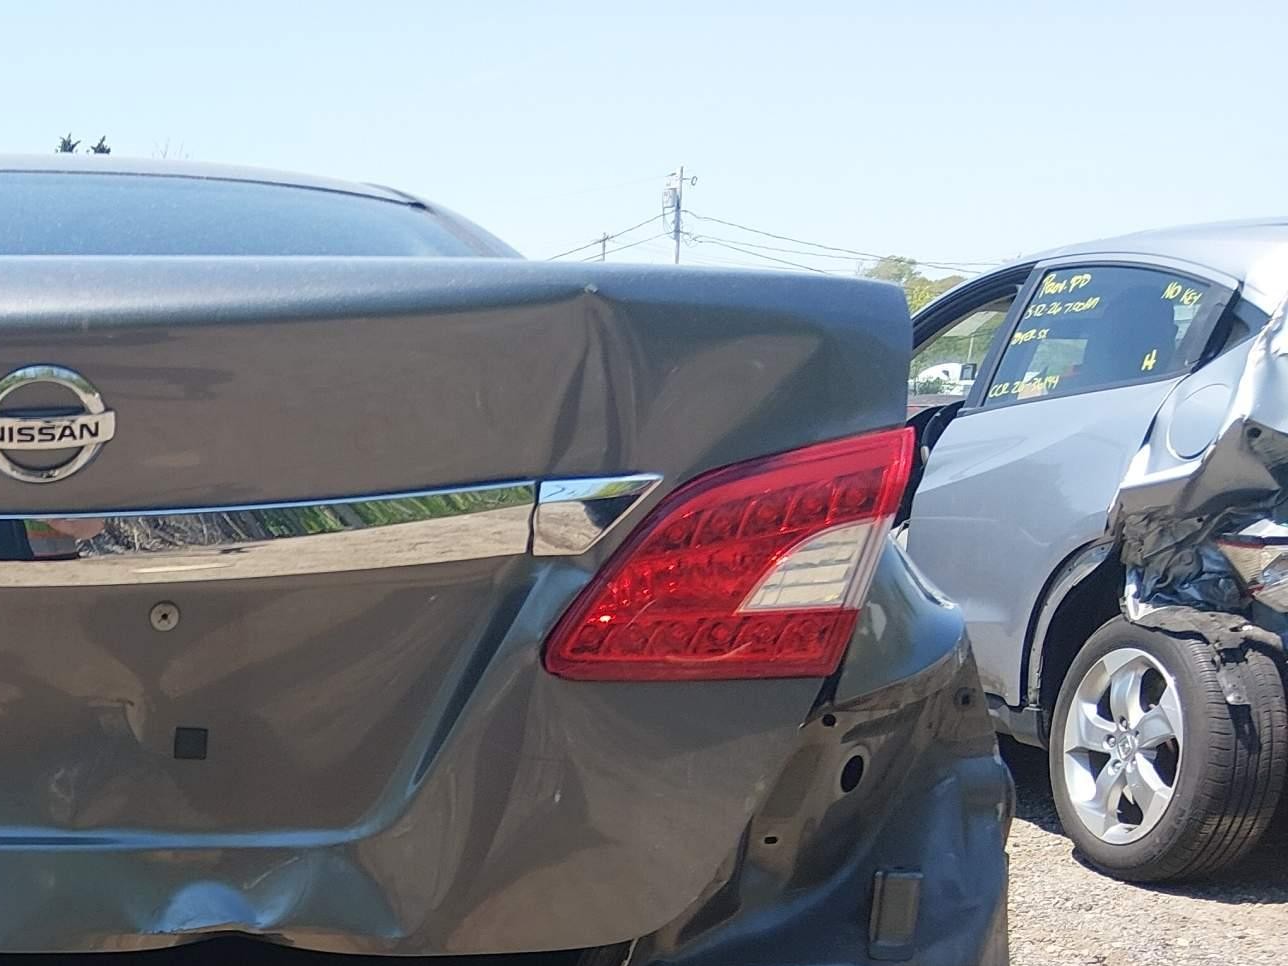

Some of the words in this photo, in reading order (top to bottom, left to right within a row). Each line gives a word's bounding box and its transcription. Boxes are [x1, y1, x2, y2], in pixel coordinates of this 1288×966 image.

[1068, 273, 1092, 293] PD
[1160, 281, 1182, 300] NO
[1180, 288, 1203, 308] KEY
